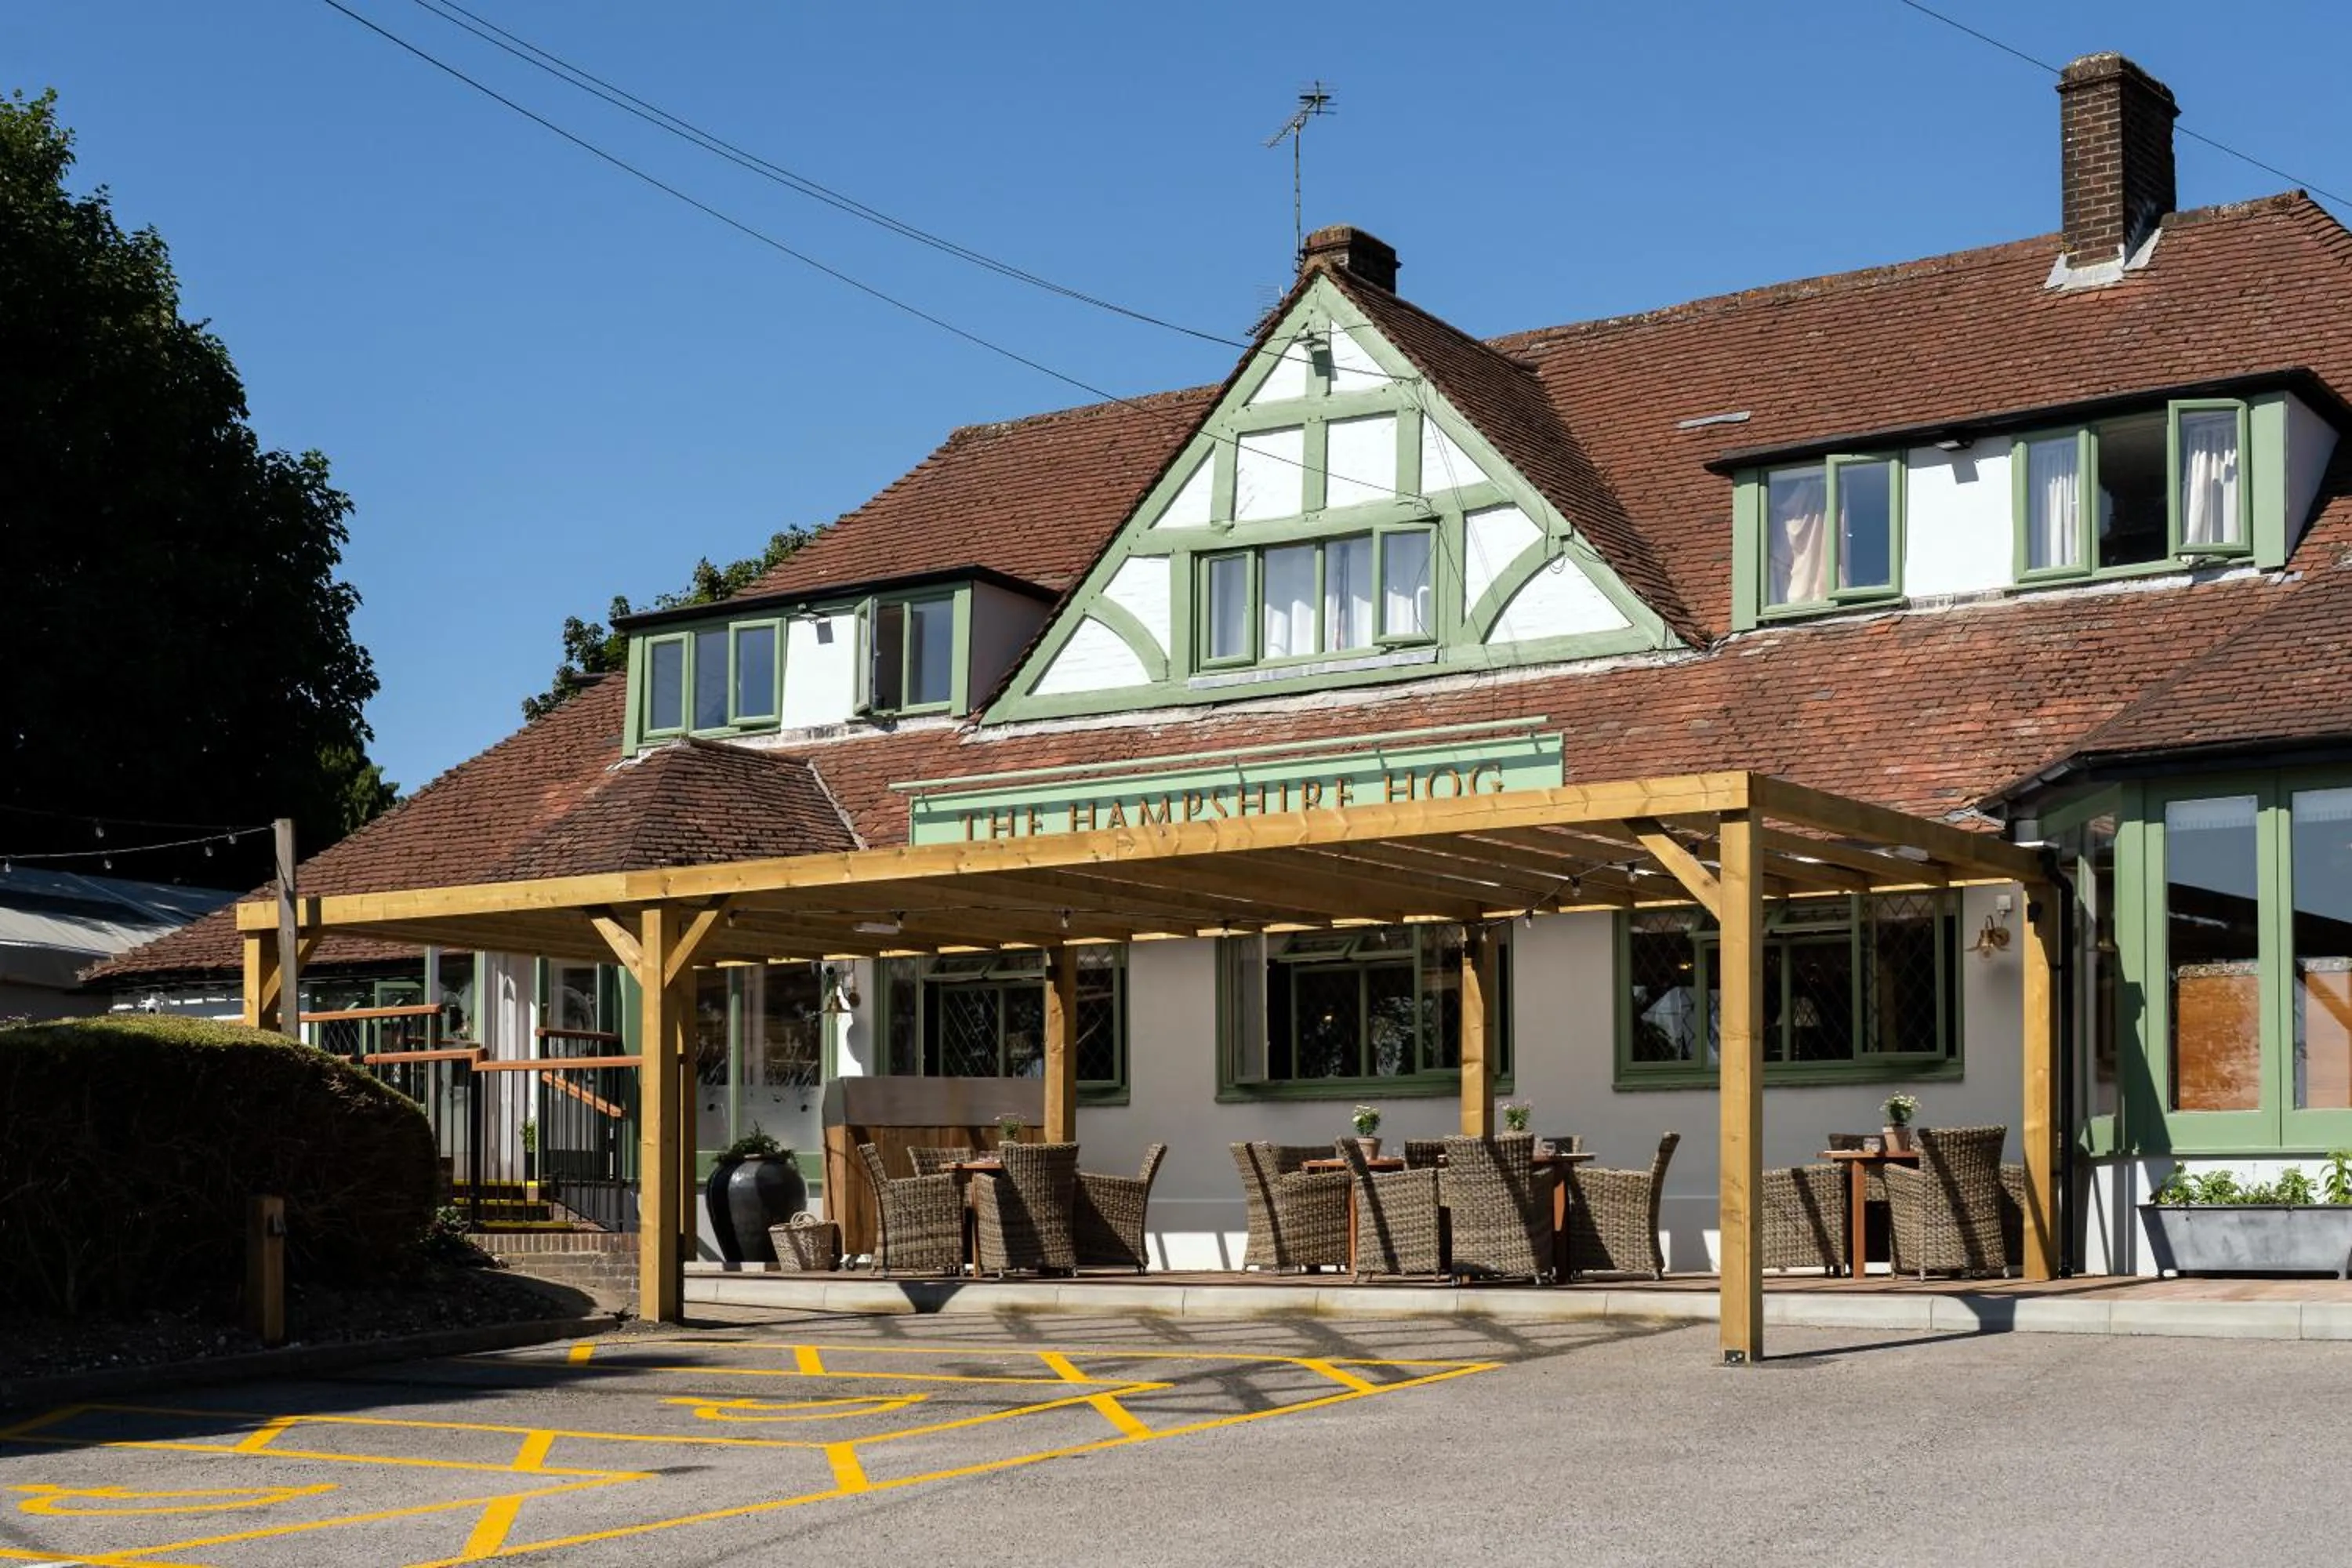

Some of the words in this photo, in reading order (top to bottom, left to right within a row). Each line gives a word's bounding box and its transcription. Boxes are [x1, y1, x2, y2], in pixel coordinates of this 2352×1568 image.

[957, 805, 1044, 841] THE
[1069, 778, 1356, 833] HAMPSHIRE
[1385, 761, 1504, 804] HOG
